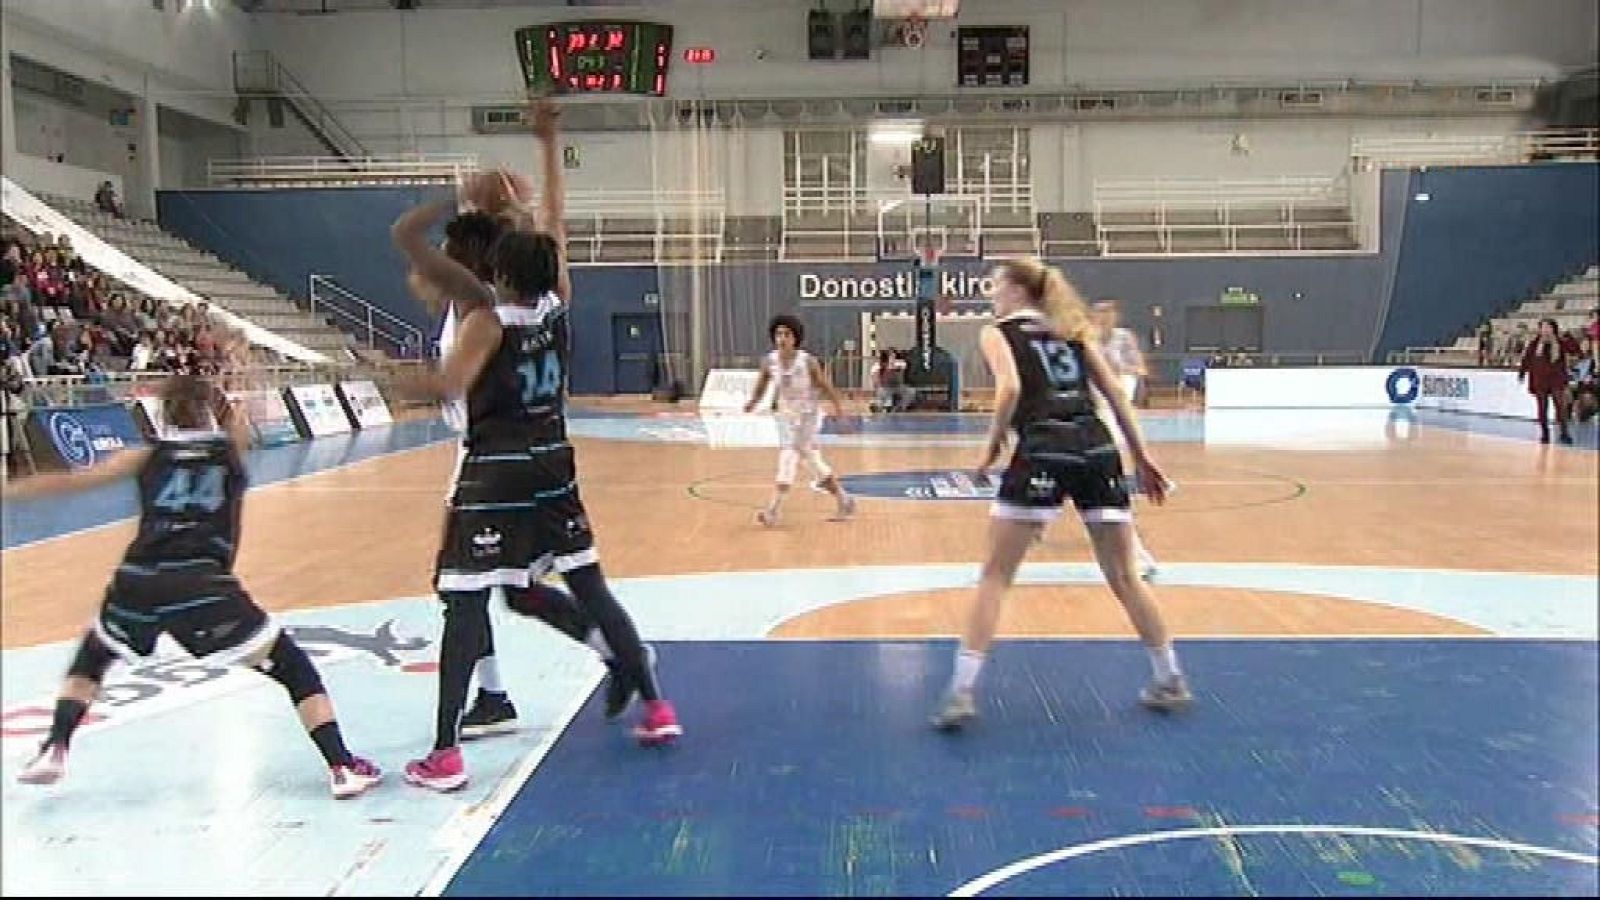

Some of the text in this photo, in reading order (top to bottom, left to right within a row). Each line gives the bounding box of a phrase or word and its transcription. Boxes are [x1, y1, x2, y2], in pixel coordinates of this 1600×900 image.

[799, 271, 996, 298] Donosti kiro
[516, 350, 562, 404] 14
[1029, 339, 1079, 387] 13
[152, 464, 227, 513] 44
